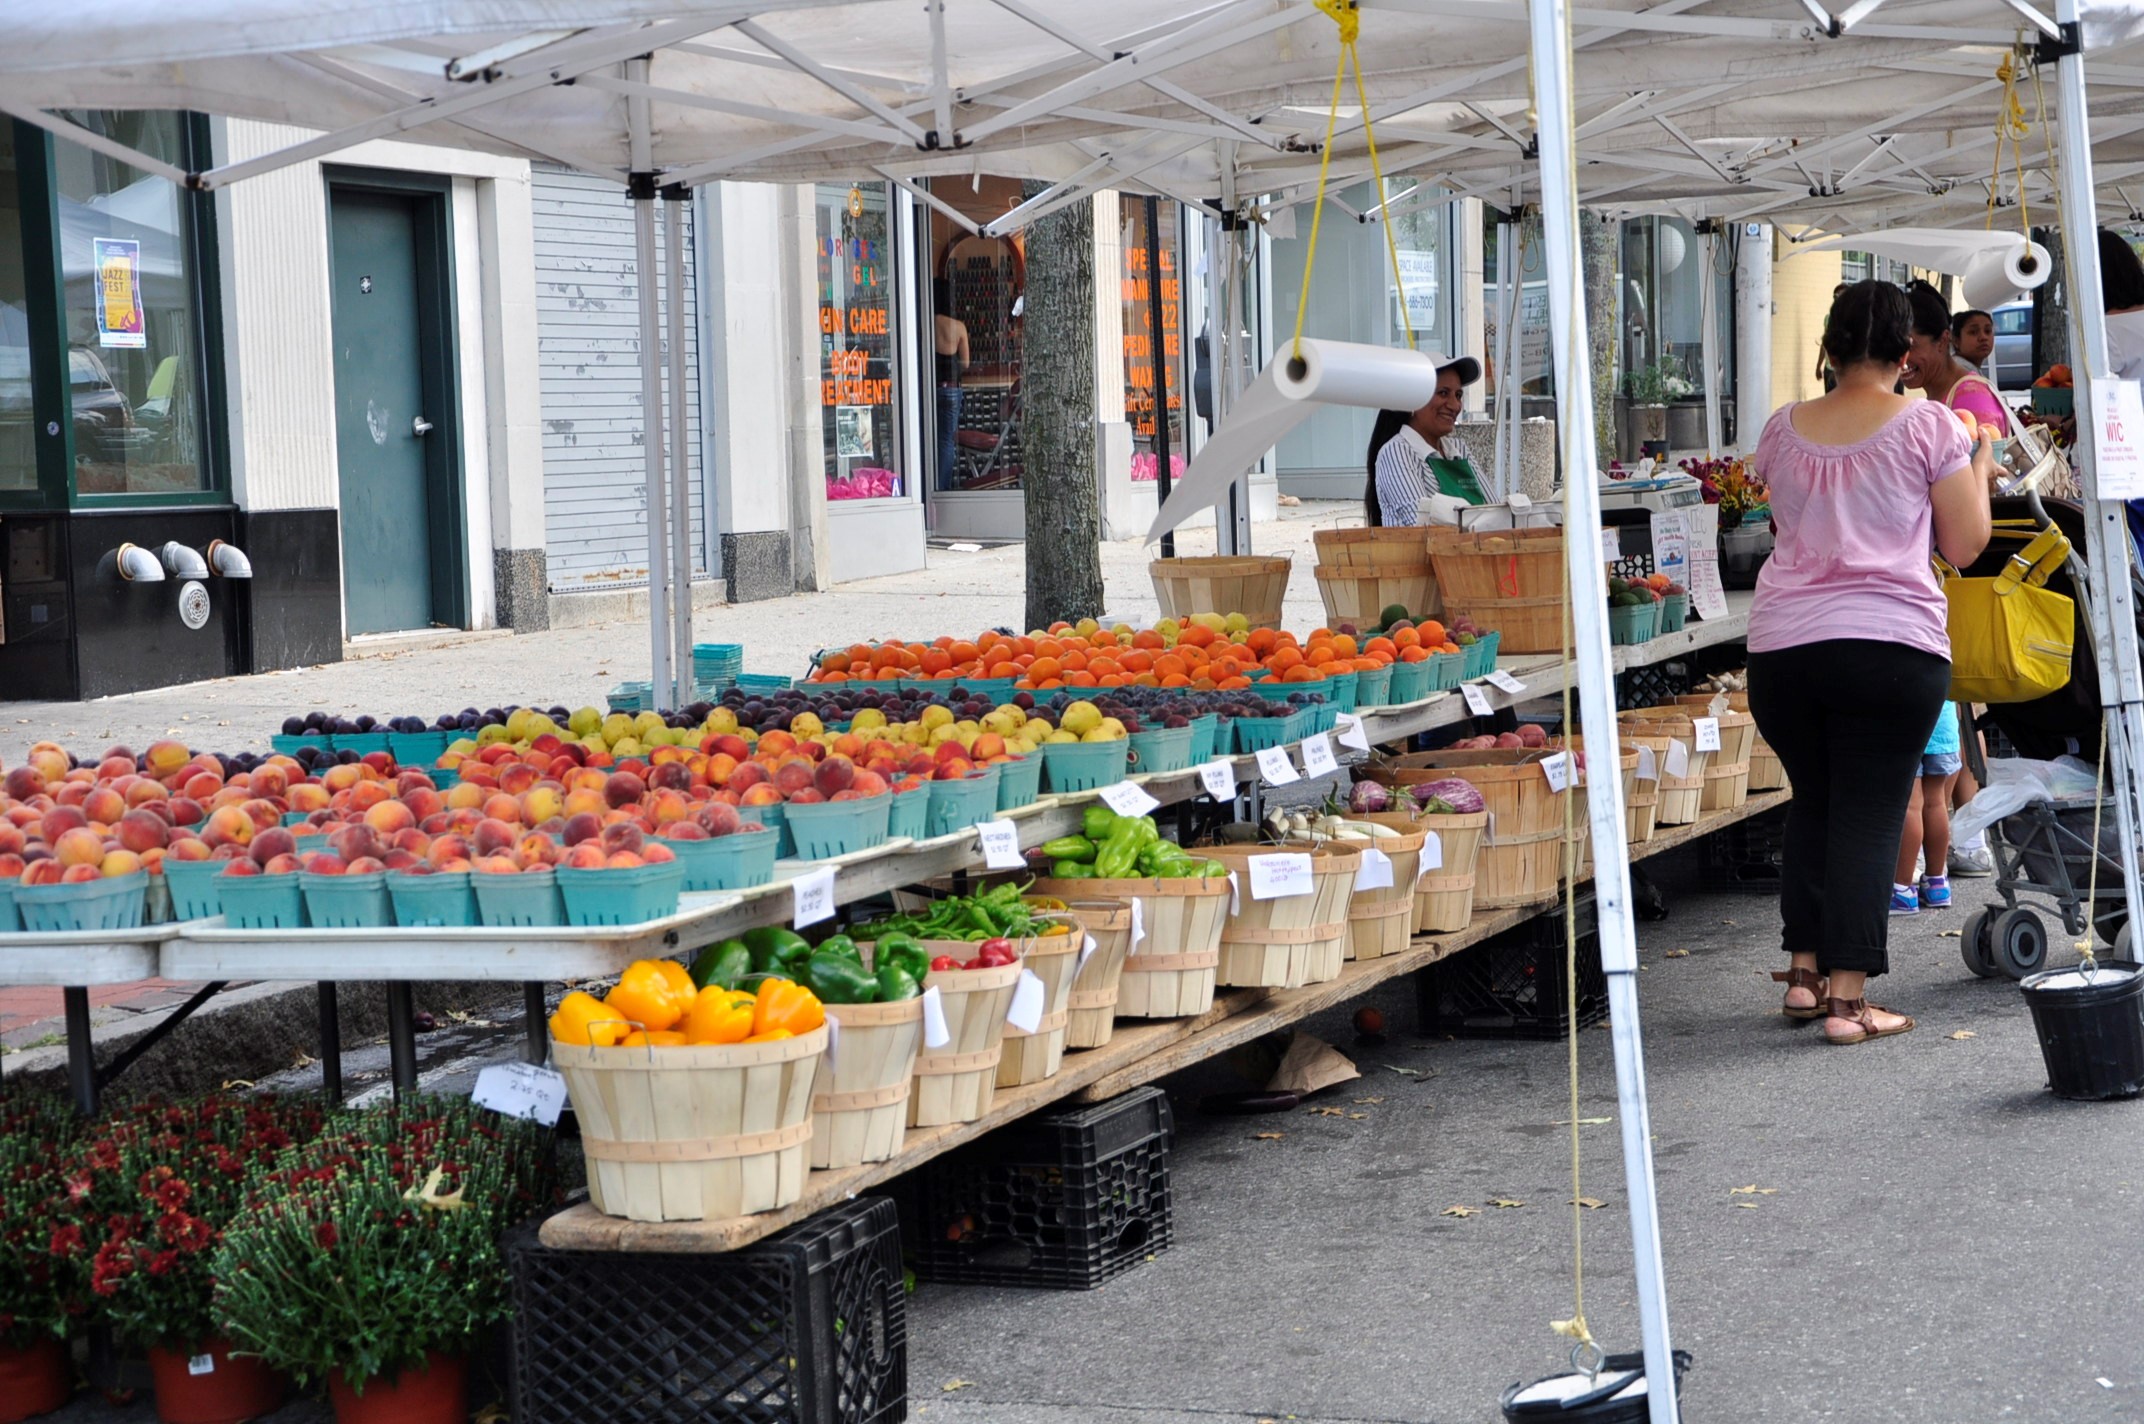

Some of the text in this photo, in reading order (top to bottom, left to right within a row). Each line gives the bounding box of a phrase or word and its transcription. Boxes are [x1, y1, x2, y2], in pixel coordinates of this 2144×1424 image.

[817, 237, 842, 256] LOR
[1125, 247, 1174, 271] SPEAL
[103, 269, 124, 281] JAZZ
[853, 265, 876, 286] GEL
[104, 281, 124, 293] FEST
[1121, 278, 1179, 301] MANIRE
[819, 307, 887, 334] KIN CARE
[1124, 334, 1179, 357] PEDIRE
[831, 350, 869, 376] BODY
[1130, 365, 1173, 388] WAXG
[820, 379, 892, 406] REATMENT
[1124, 392, 1137, 412] ift
[1136, 415, 1156, 436] Avail
[2105, 421, 2125, 443] WIC
[892, 477, 900, 497] A
